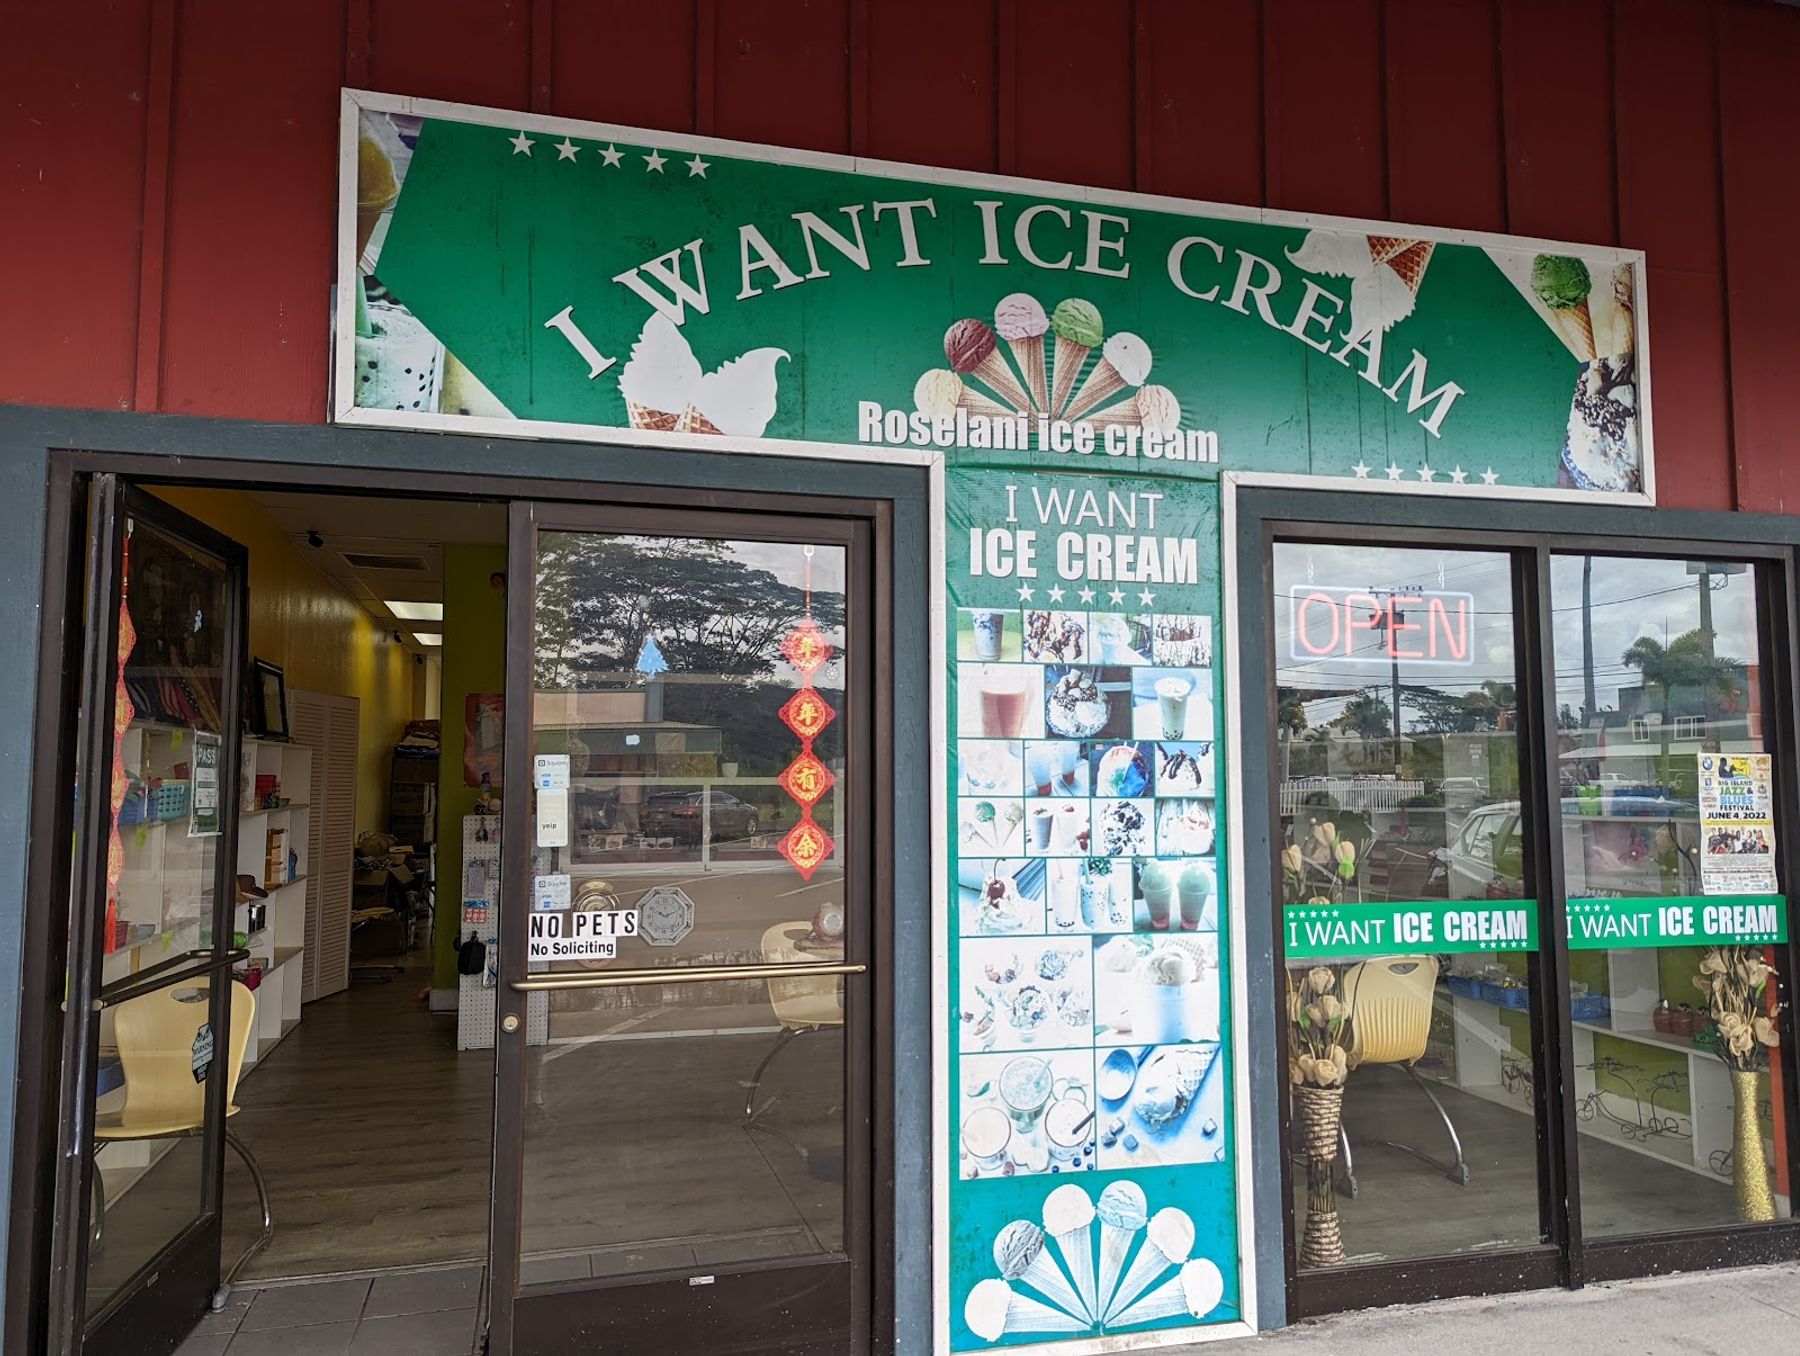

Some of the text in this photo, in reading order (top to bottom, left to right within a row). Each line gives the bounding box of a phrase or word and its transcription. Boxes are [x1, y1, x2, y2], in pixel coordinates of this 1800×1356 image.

[544, 197, 1466, 440] I WANT ICE CREAM
[858, 401, 1219, 464] Roselani ice cream
[1005, 485, 1164, 529] I WANT
[969, 527, 1198, 584] ICE CREAM
[1299, 592, 1466, 660] OPEN
[198, 748, 215, 763] PASS
[1719, 786, 1754, 796] JAZZ &
[1720, 796, 1754, 805] BLUES
[541, 822, 557, 830] yelp
[1733, 812, 1742, 820] 4,
[1743, 812, 1766, 820] 2022
[531, 915, 560, 938] NO
[576, 911, 635, 937] PETS
[1289, 910, 1527, 947] I WANT ICE CREAM
[1566, 905, 1778, 939] I WANT ICE CREAM
[531, 941, 614, 955] No Soliciting
